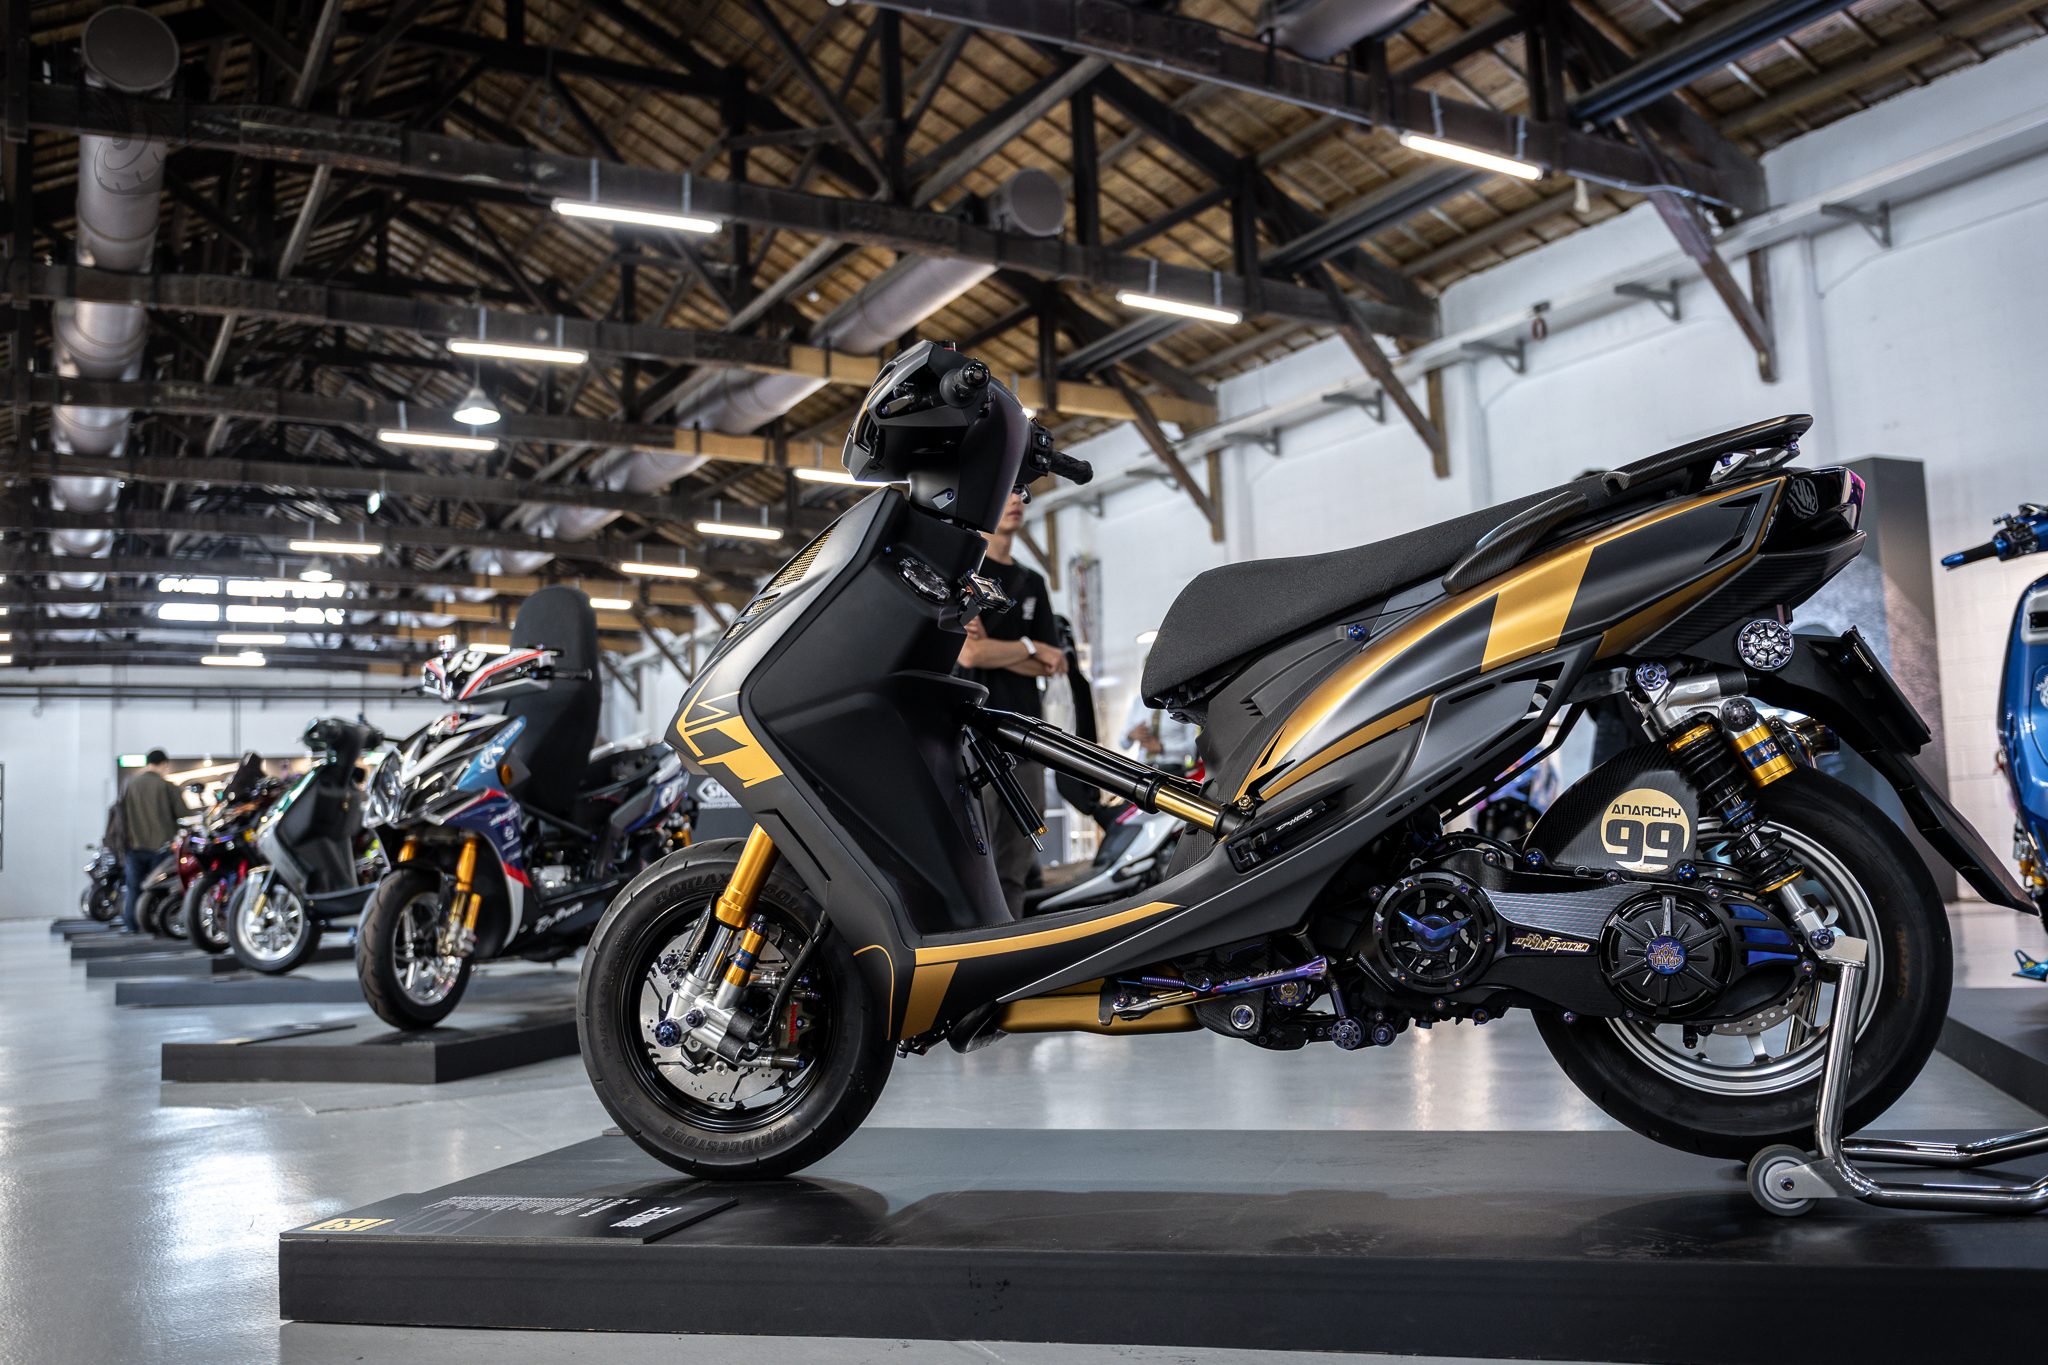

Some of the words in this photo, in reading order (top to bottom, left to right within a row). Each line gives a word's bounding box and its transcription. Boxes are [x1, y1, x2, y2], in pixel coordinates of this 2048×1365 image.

[1611, 804, 1681, 818] ANARCHY
[1605, 819, 1685, 864] 99
[1896, 930, 1909, 999] MAXXIS
[789, 1004, 799, 1042] brembo
[661, 1124, 787, 1154] BRIDGESTONE
